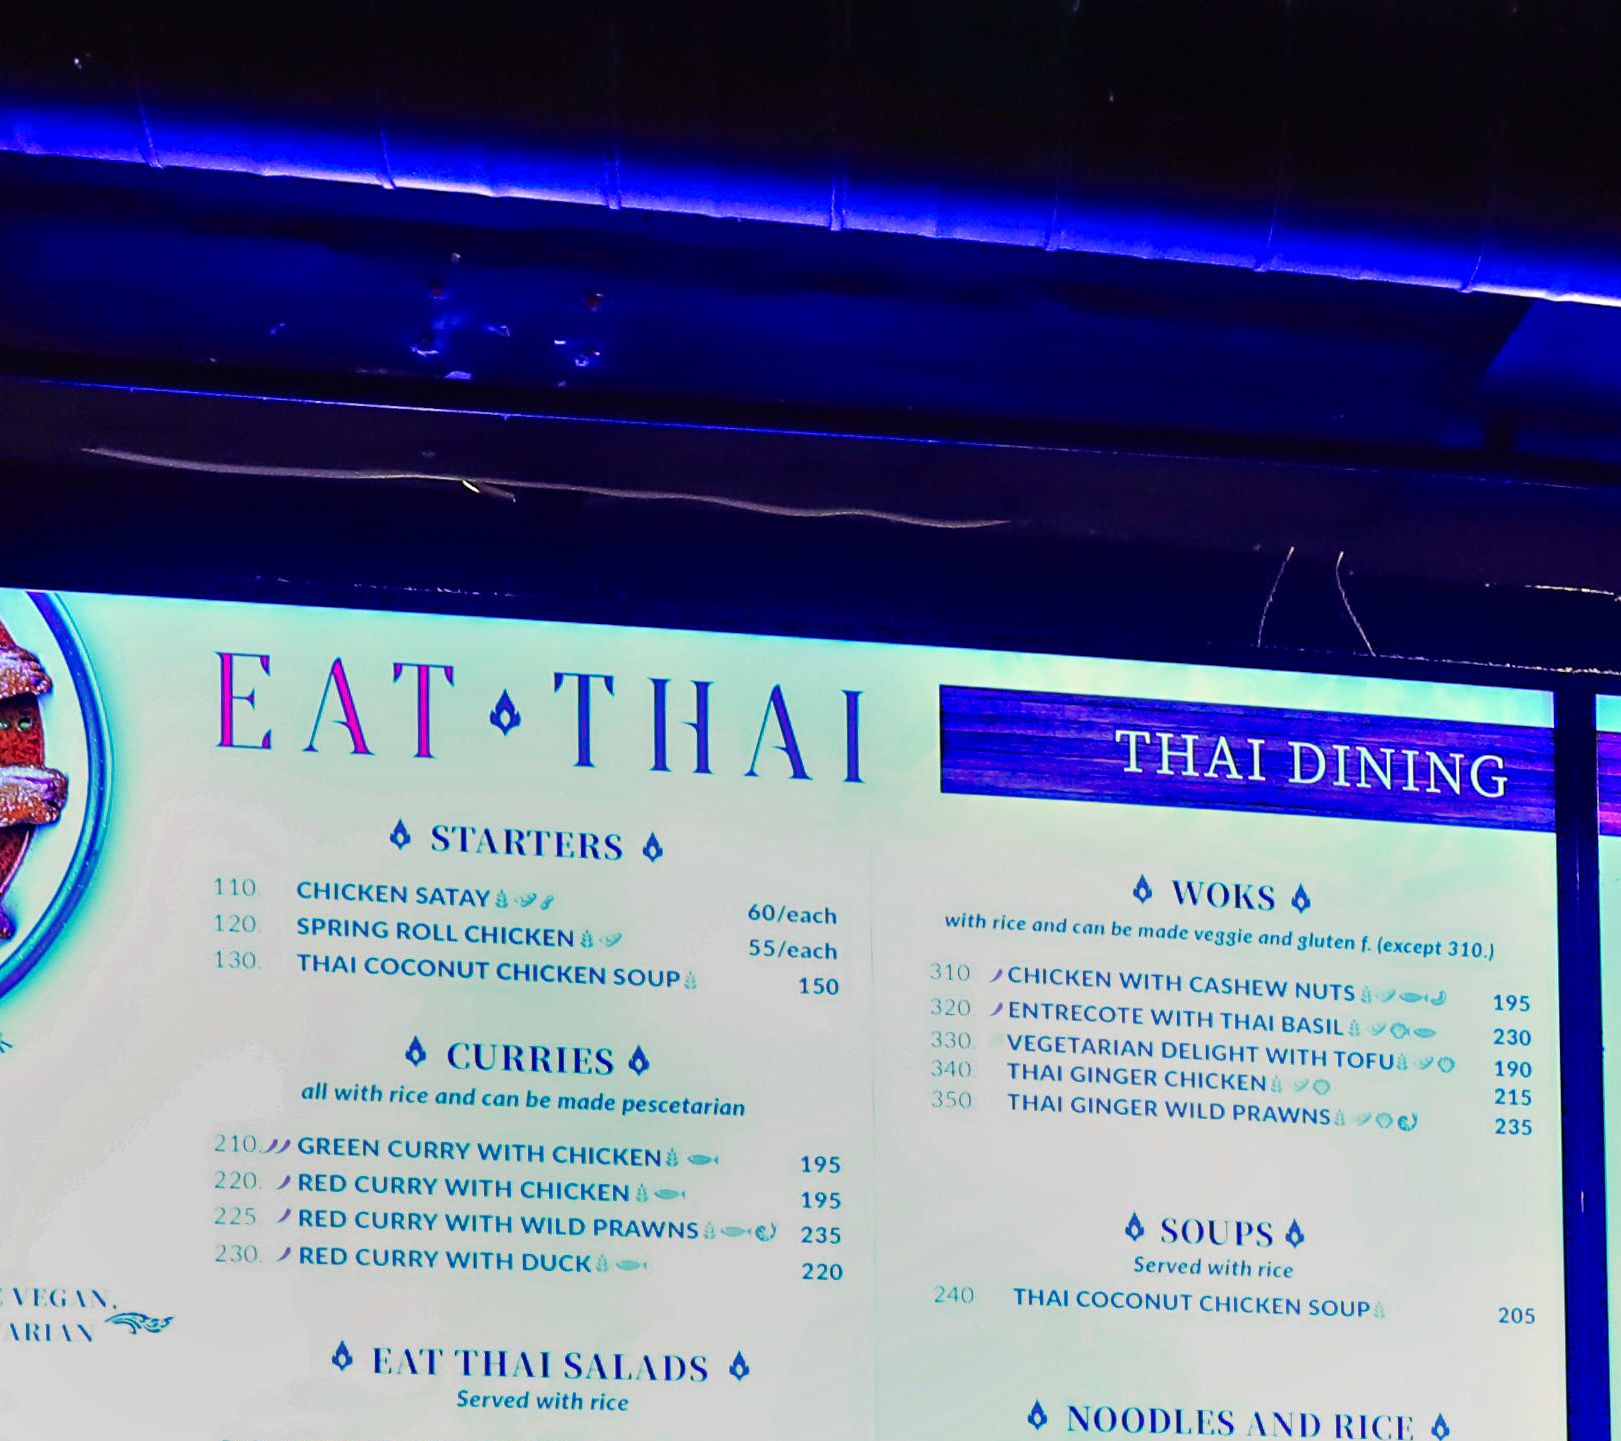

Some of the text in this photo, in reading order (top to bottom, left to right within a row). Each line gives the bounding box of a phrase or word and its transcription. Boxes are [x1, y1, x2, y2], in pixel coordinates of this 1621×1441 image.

[215, 652, 866, 783] EAT THAI
[1114, 730, 1508, 797] THAI DINING
[432, 825, 623, 860] STARTERS
[297, 881, 836, 924] CHICKEN SATAY 60/each
[1173, 880, 1274, 911] WOKS
[298, 918, 837, 960] SPRING ROLL CHICKEN 55/each
[297, 954, 839, 995] THAI COCONUT CHICKEN SOUP 150
[1008, 967, 1530, 1012] CHICKEN WITH CASHEW NUTS 195
[448, 1043, 614, 1075] CURRIES
[1007, 1034, 1532, 1078] VEGETARIAN DELIGHT WITH TOFU 190
[302, 1082, 745, 1116] all with rice and can be made pescetarian
[1008, 1094, 1532, 1135] THAI GINGER WILD PRAWNS 235
[298, 1137, 840, 1173] GREEN CURRY WITH CHICKEN 195
[1162, 1218, 1272, 1247] SOUPS
[374, 1348, 708, 1382] EAT THAI SALADS
[1068, 1405, 1413, 1440] NOODLES AND RICE
